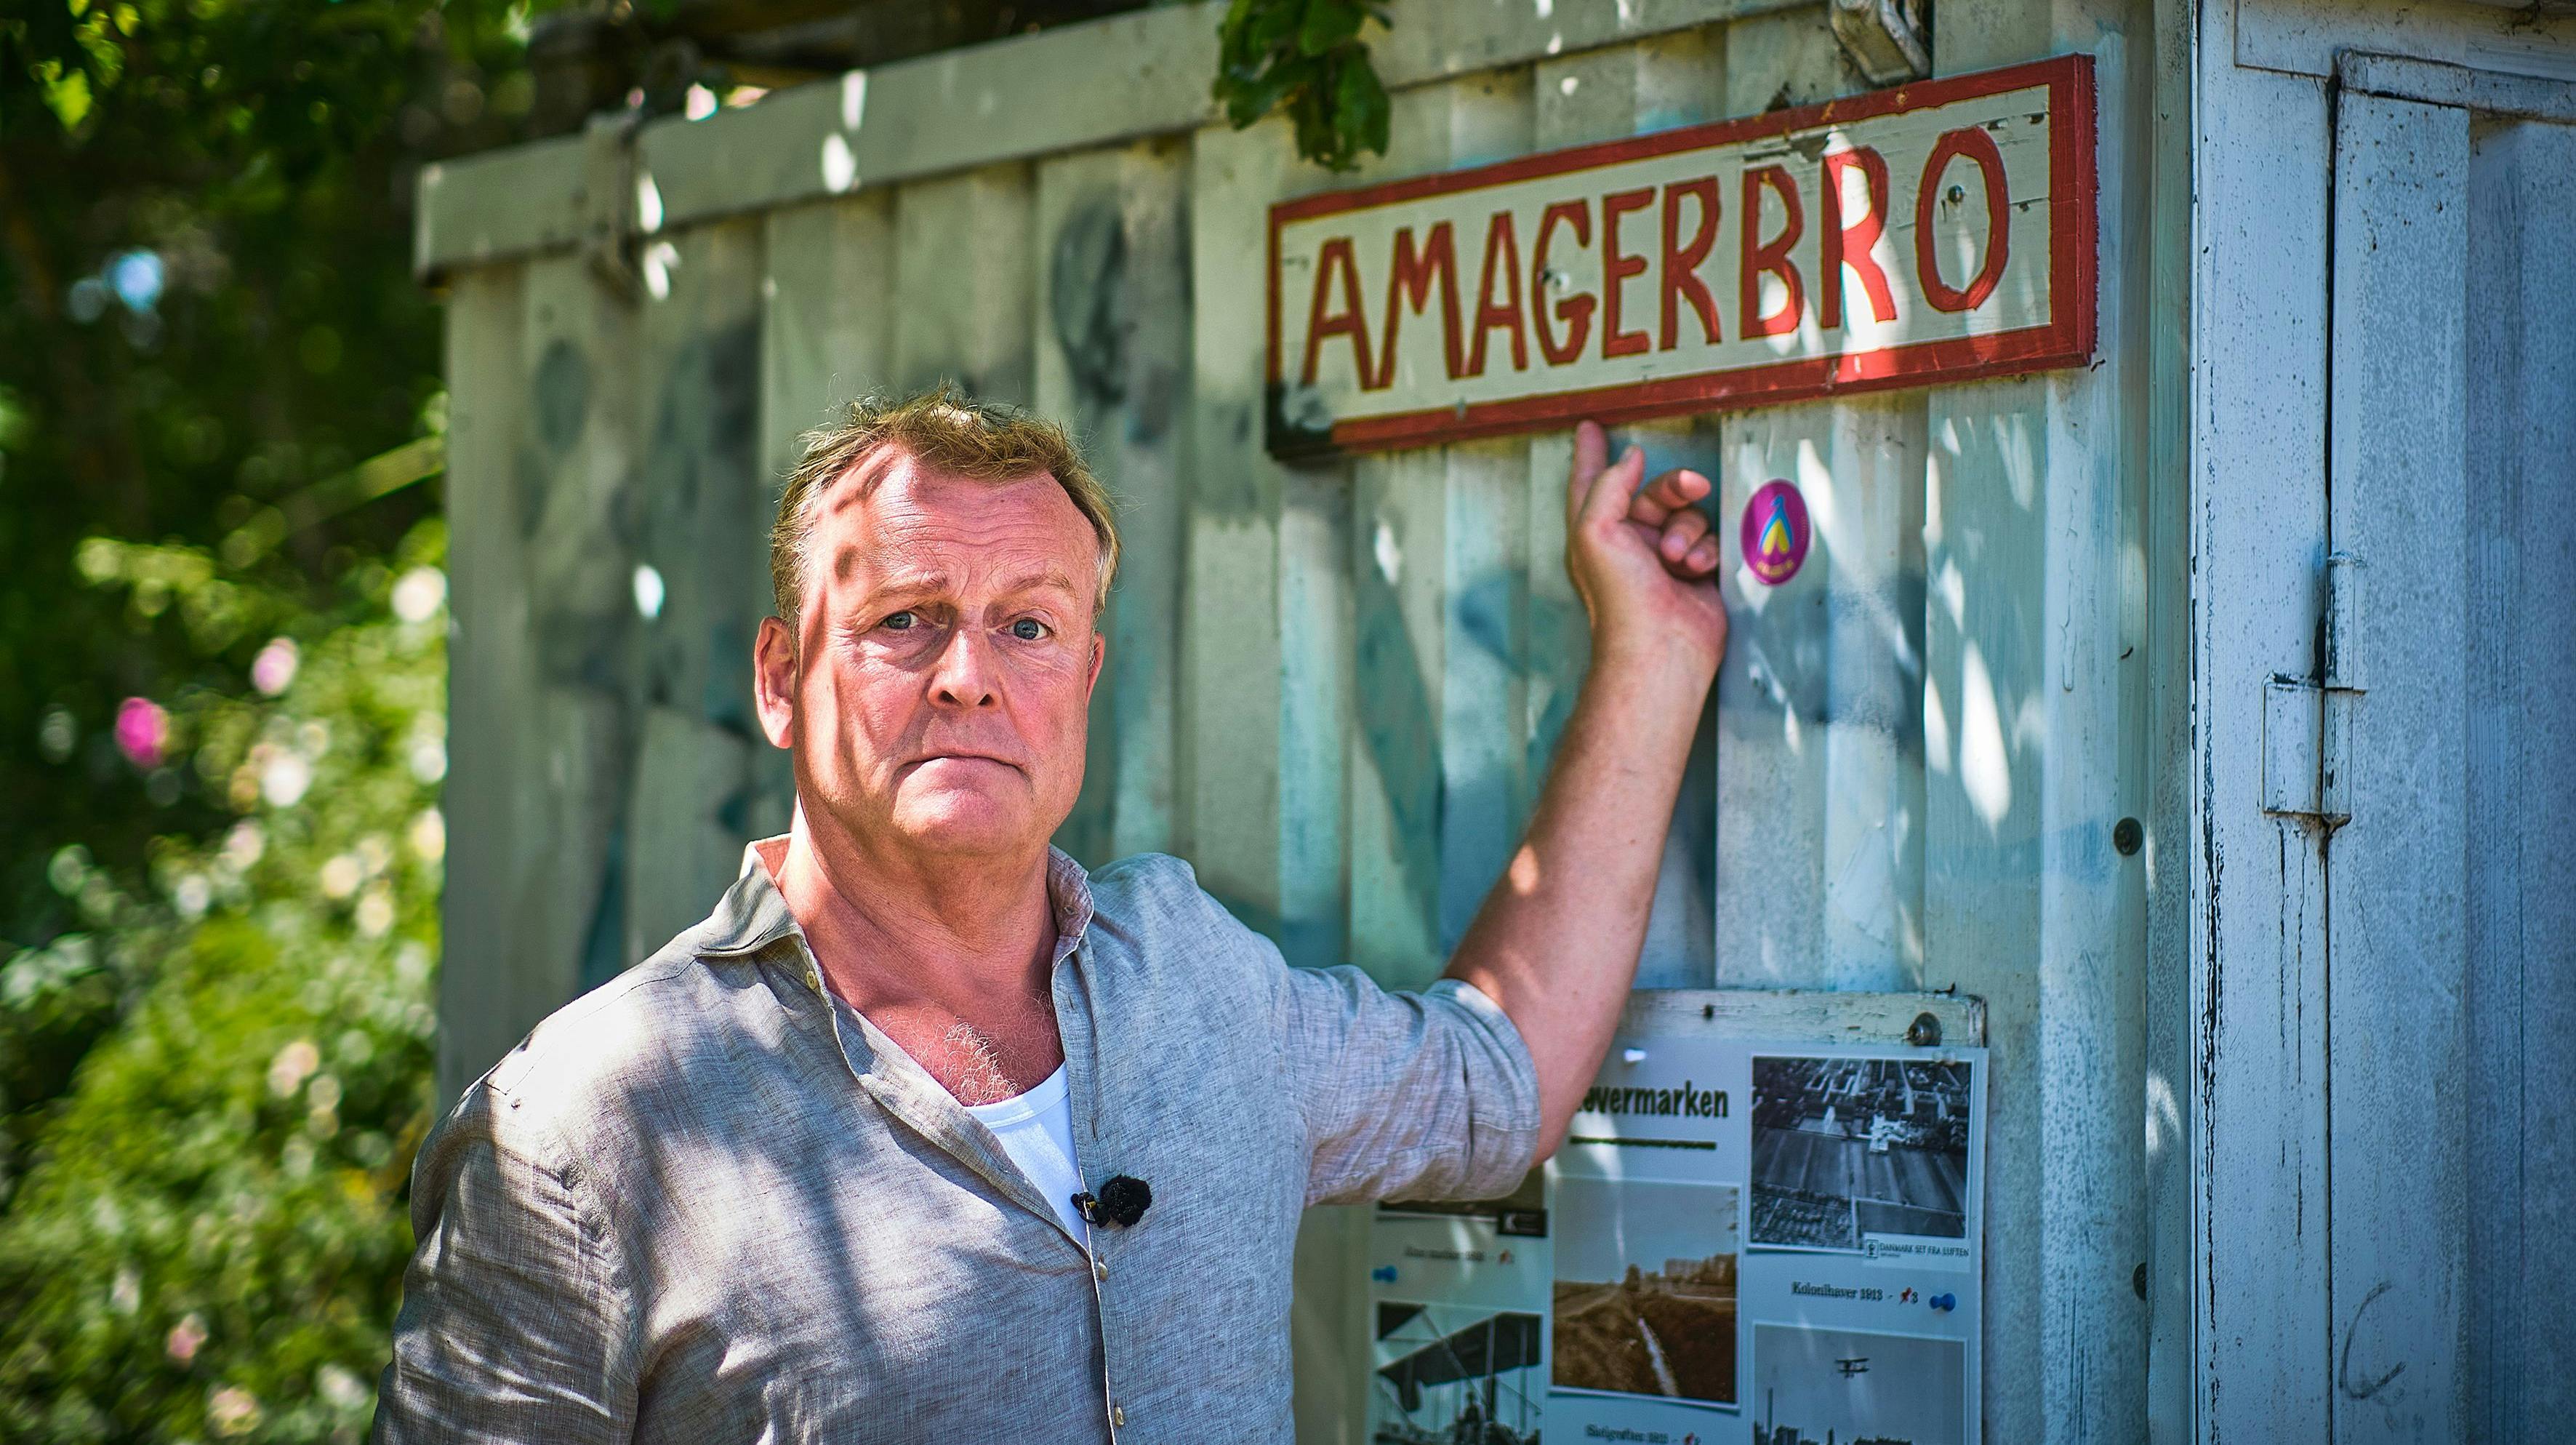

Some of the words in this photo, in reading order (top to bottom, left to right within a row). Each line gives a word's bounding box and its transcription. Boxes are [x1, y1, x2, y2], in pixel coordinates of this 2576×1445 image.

[1302, 126, 2009, 391] AMAGERBRO
[1577, 1080, 1728, 1117] øvermarken
[1791, 1281, 1858, 1299] Kolonihaver
